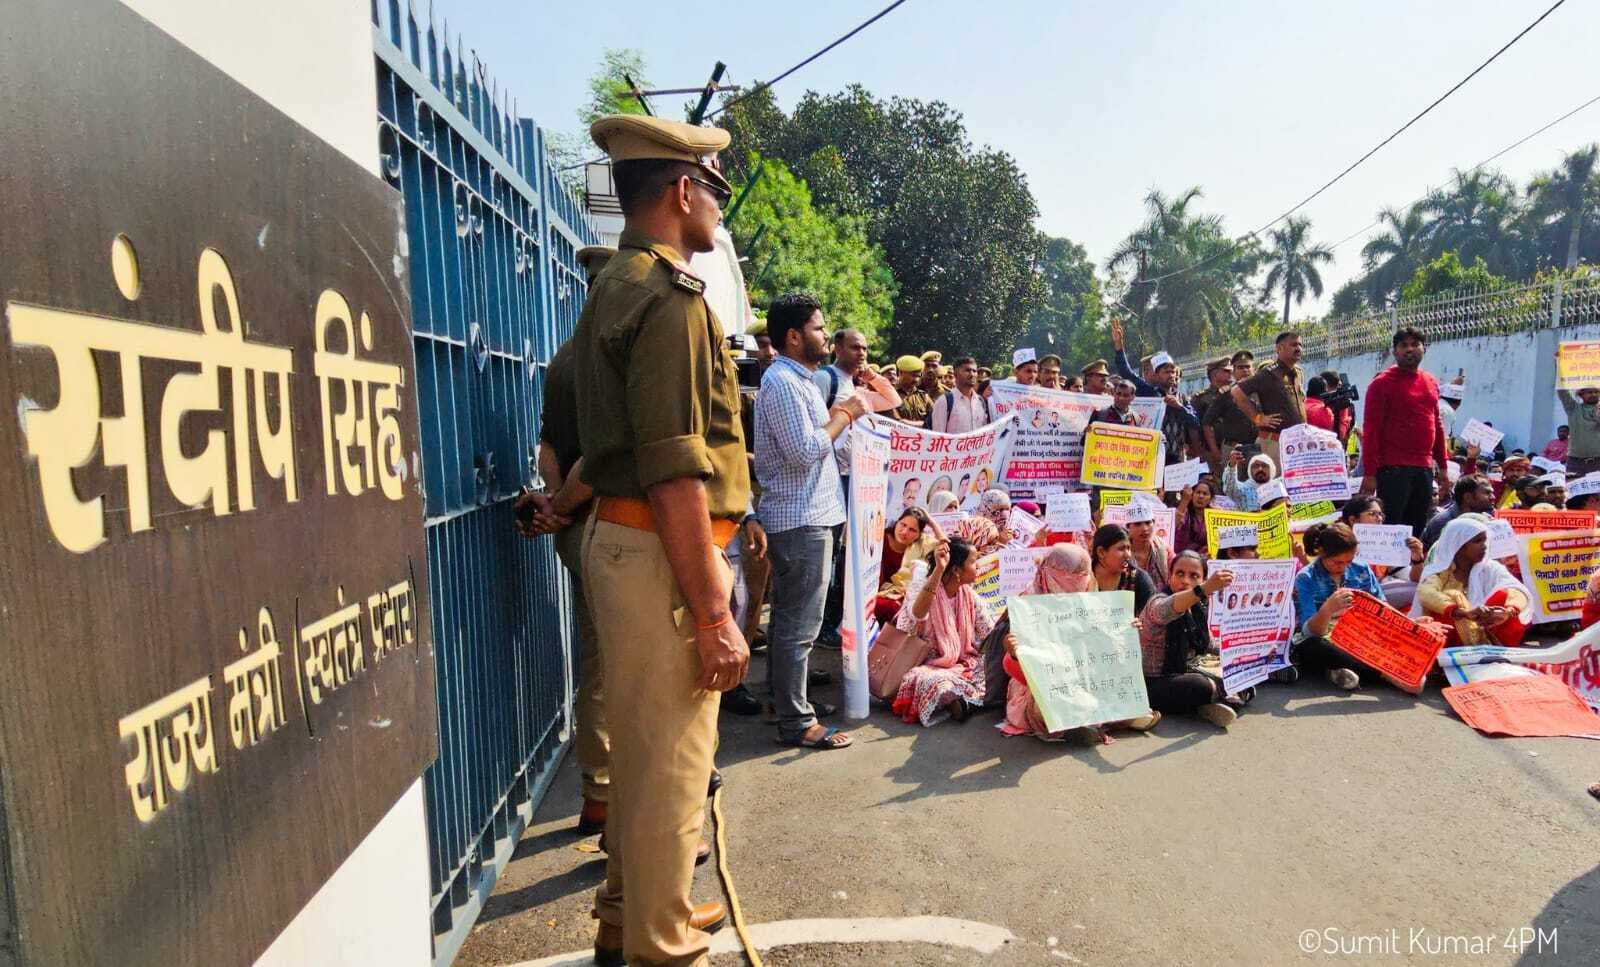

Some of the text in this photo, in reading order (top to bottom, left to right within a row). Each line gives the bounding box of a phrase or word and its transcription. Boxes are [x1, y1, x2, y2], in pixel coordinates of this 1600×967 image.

[6, 232, 405, 554] संदीप सिंह
[889, 459, 915, 474] क्षण
[919, 459, 936, 474] पर
[1543, 552, 1560, 564] योगी
[1562, 553, 1572, 562] जी
[118, 674, 219, 823] राज्य
[223, 606, 286, 750] मंत्री
